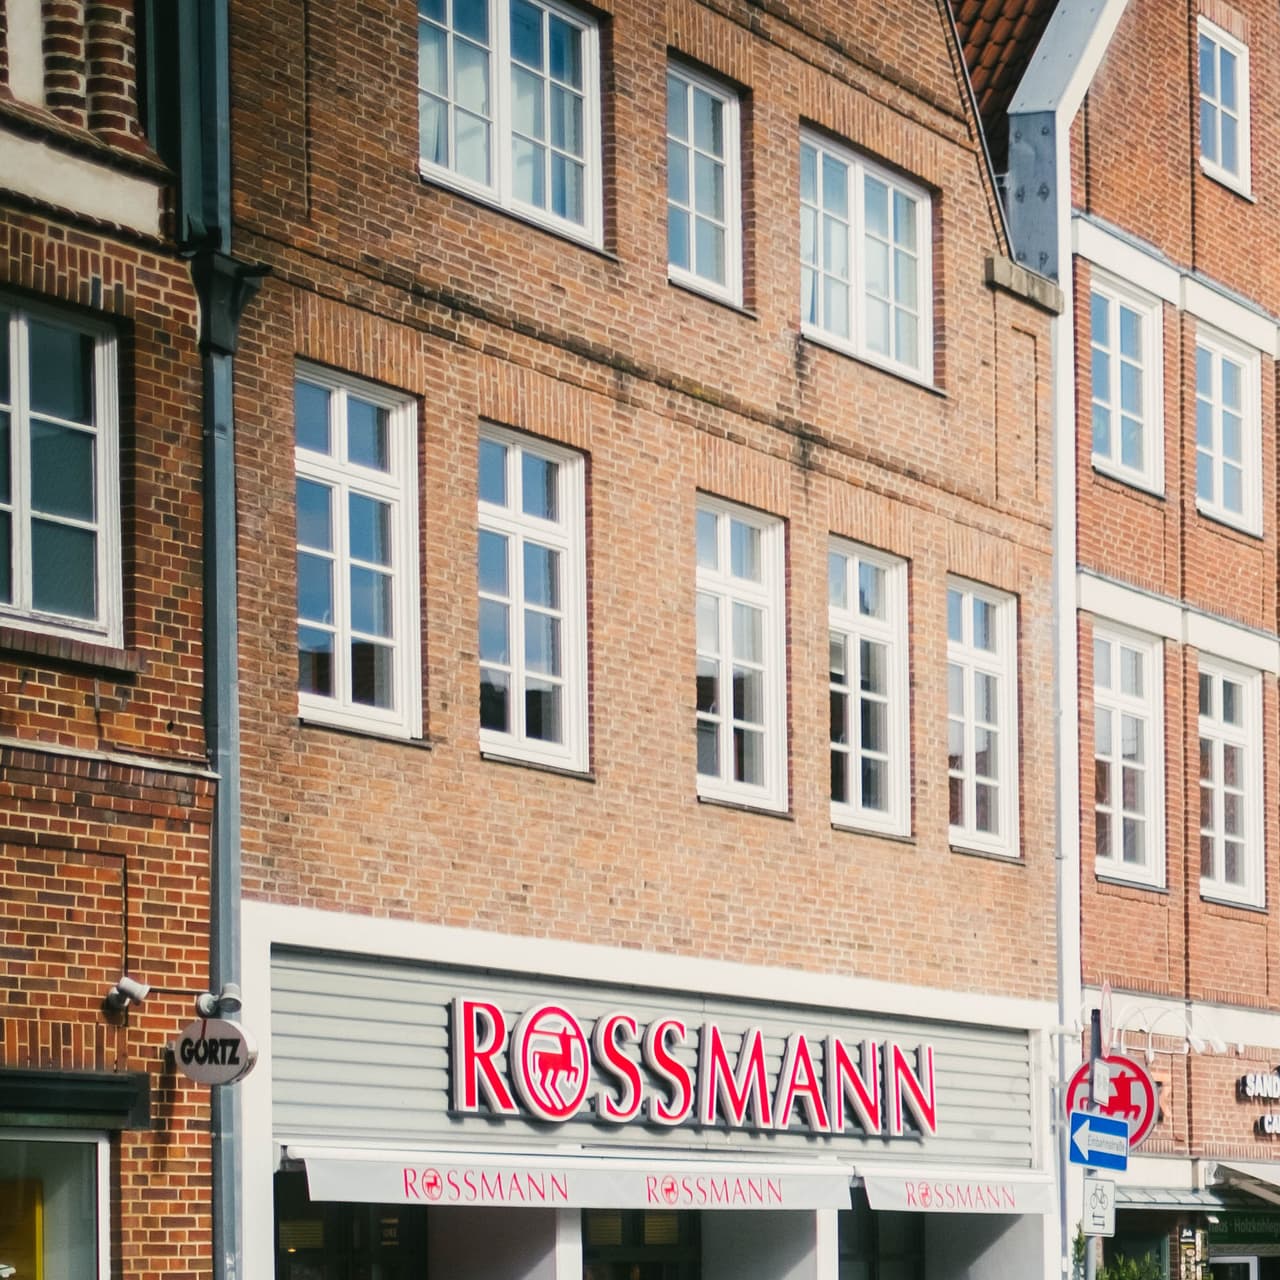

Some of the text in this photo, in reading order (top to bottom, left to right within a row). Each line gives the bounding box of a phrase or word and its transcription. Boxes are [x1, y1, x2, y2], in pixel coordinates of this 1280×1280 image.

[454, 996, 938, 1137] ROSSMANN
[403, 1167, 569, 1202] ROSSMANN
[646, 1174, 783, 1205] ROSSMANN
[905, 1180, 1016, 1210] ROSSMANN
